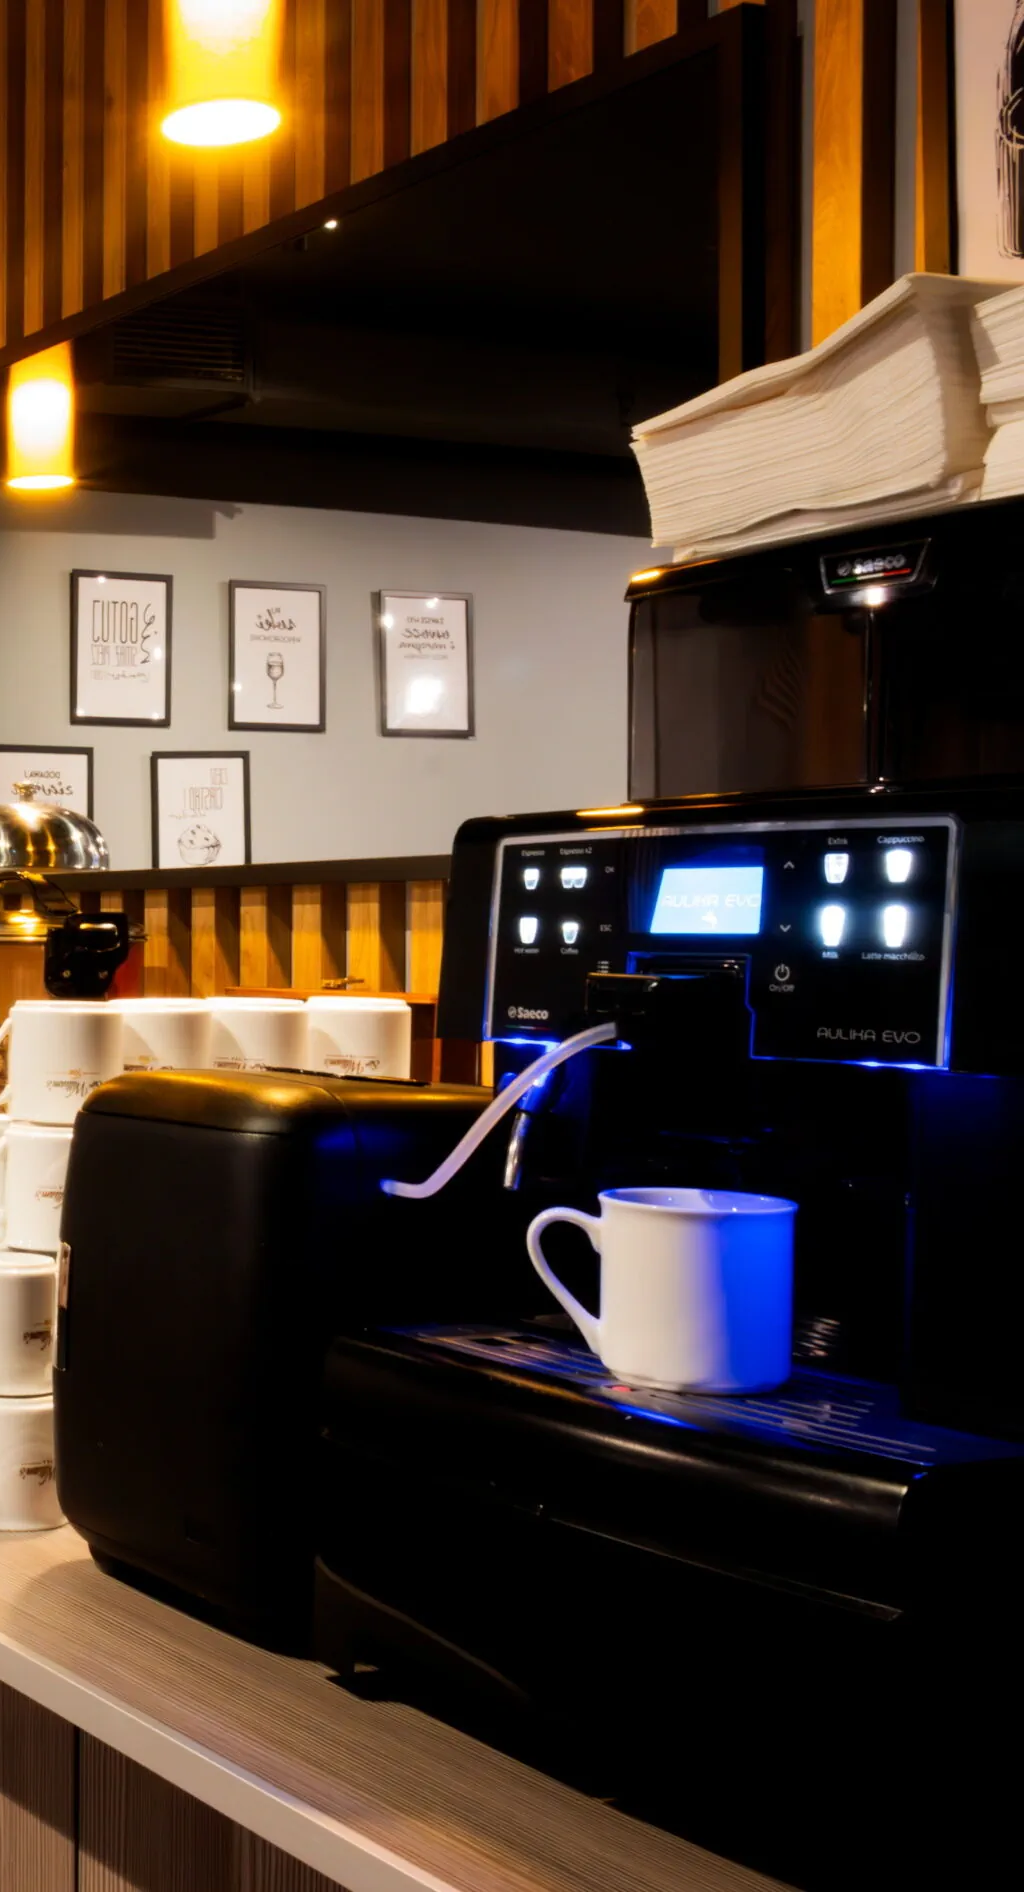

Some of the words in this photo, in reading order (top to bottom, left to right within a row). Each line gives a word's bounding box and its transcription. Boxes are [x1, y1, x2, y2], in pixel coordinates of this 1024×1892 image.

[853, 554, 906, 575] Saeco
[876, 835, 925, 844] Cappuccino
[516, 1006, 549, 1020] Saeco
[816, 1027, 876, 1041] AULIKA
[882, 1030, 921, 1044] EVO
